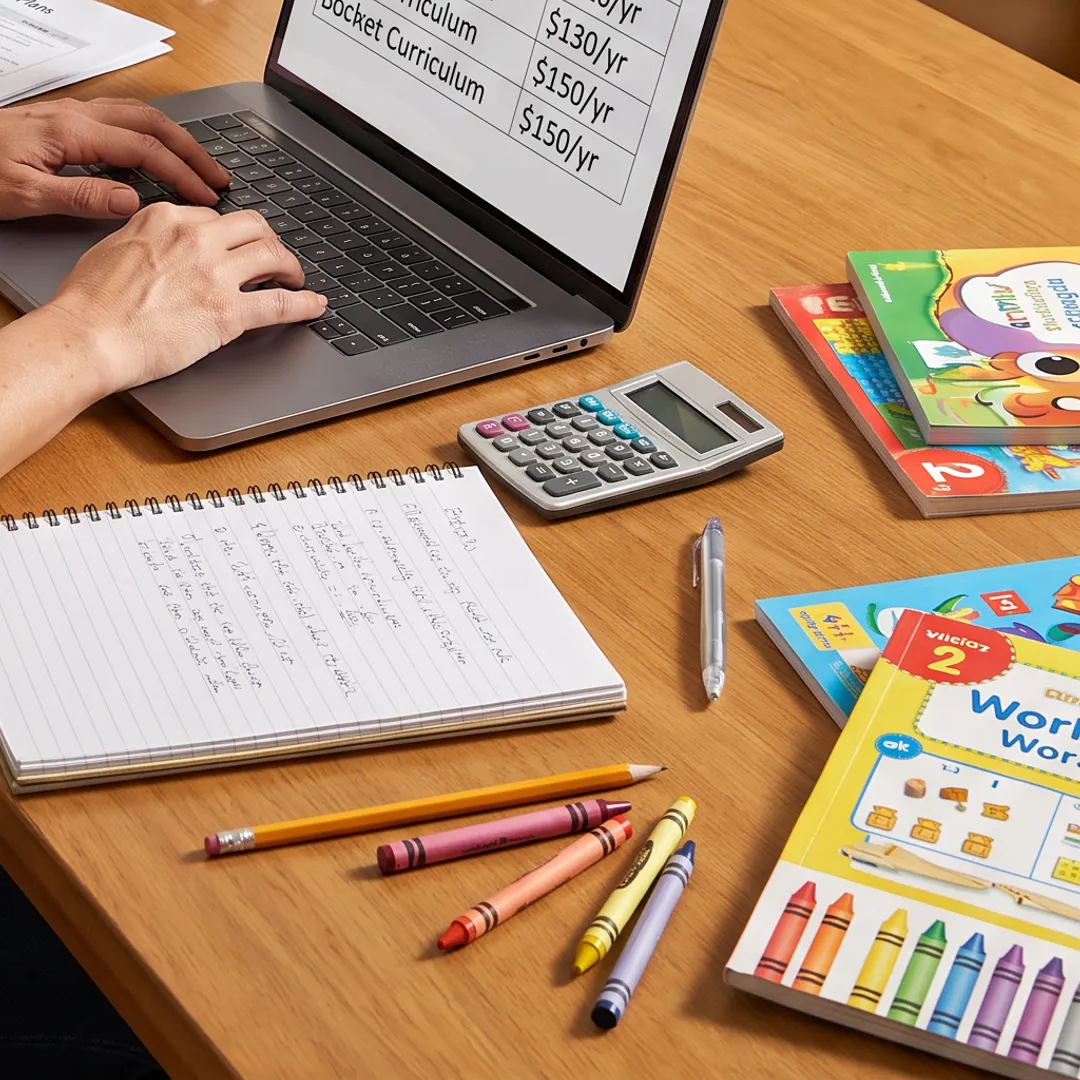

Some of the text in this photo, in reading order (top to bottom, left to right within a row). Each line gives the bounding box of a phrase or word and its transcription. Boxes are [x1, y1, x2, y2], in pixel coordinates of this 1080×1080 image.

[546, 8, 628, 74] $130/yr
[387, 26, 485, 104] Curriculum
[519, 104, 600, 172] $150/yr
[533, 56, 615, 124] $150/yr
[927, 645, 966, 676] 2
[1002, 729, 1080, 768] Wor
